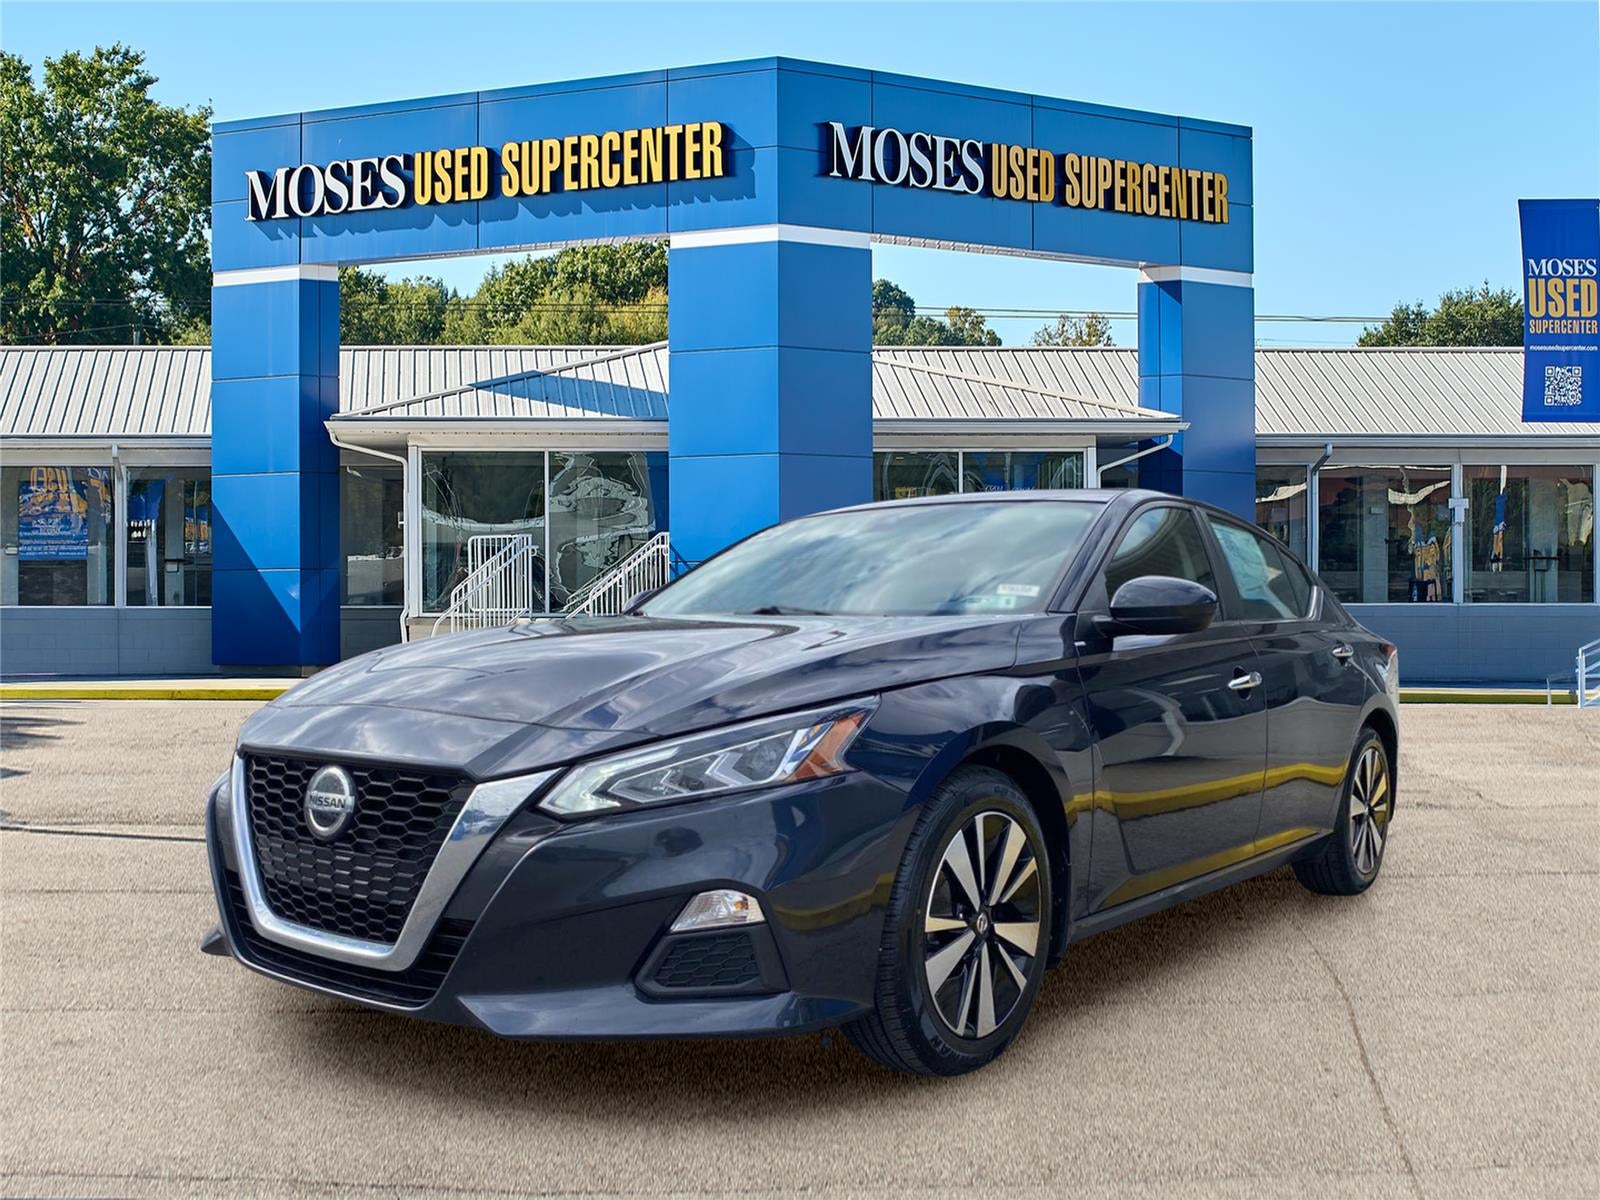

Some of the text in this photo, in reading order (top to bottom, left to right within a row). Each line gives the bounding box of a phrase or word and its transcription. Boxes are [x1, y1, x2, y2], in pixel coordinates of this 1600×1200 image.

[245, 121, 725, 222] MOSES USED SUPERCENTER
[829, 121, 1230, 223] MOSES USED SUPERCENTER
[1528, 258, 1598, 277] MOSES
[1528, 278, 1598, 318] USED
[1529, 320, 1598, 334] SUPERCENTER
[309, 796, 346, 809] NISSAN
